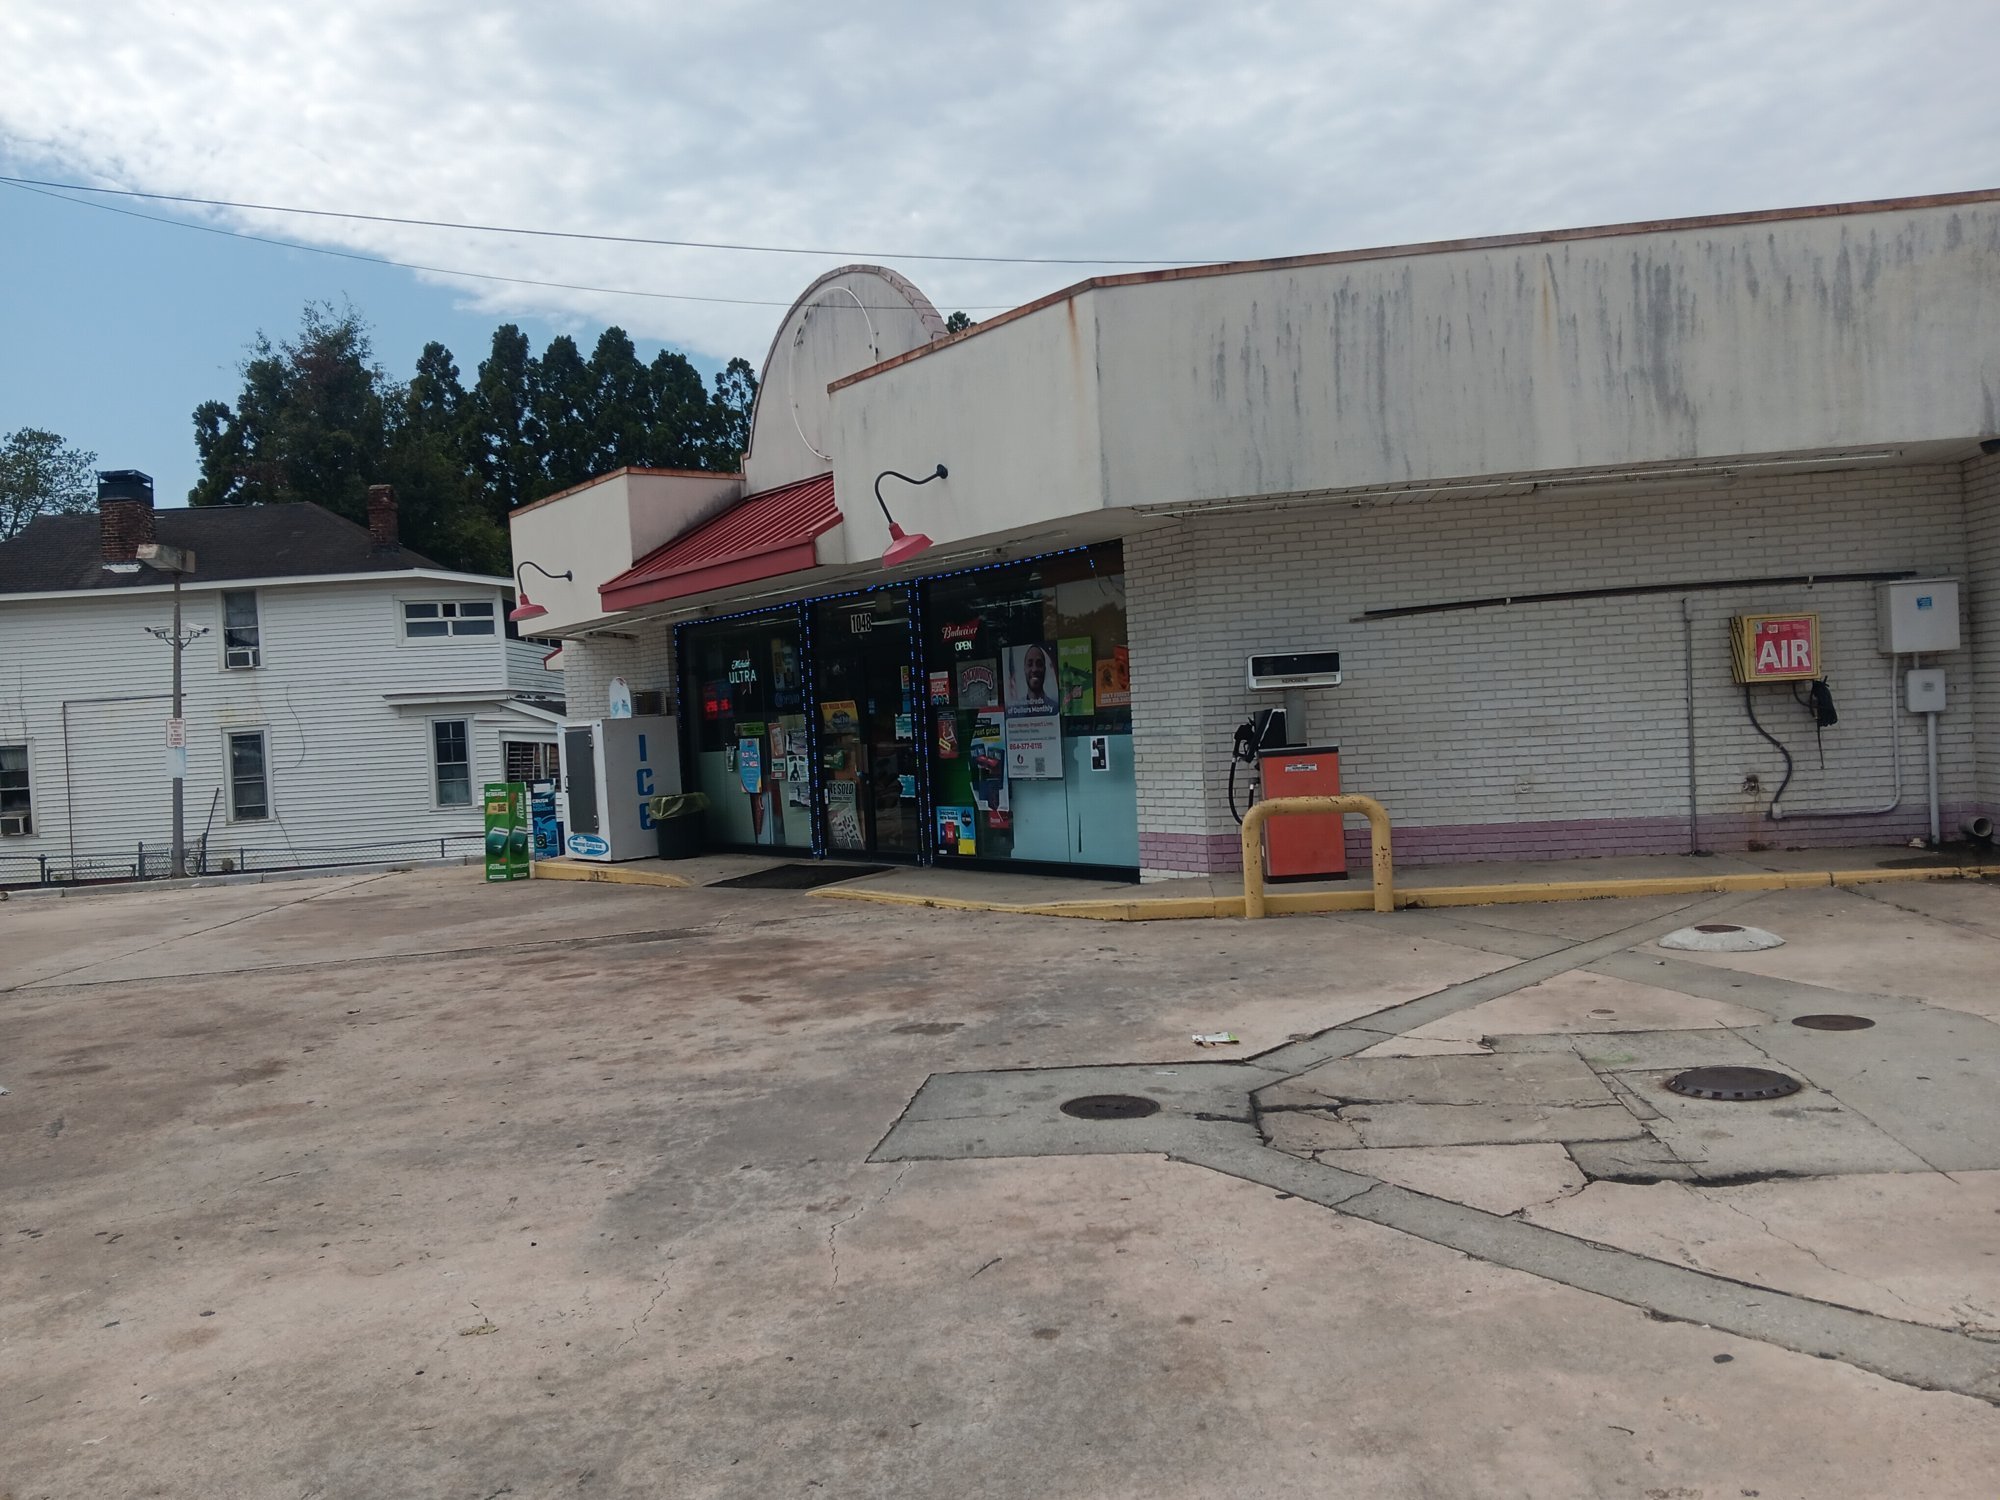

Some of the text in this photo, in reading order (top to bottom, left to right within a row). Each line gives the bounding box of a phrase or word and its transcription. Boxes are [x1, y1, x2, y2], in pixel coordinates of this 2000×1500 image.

[852, 614, 871, 632] 1048
[942, 626, 978, 639] Budweiser
[955, 641, 972, 651] OPEN
[1758, 640, 1811, 669] AIR
[728, 669, 757, 684] ULTRA
[1032, 704, 1053, 713] Monthly
[637, 734, 656, 830] ICE
[837, 784, 854, 795] SOLD
